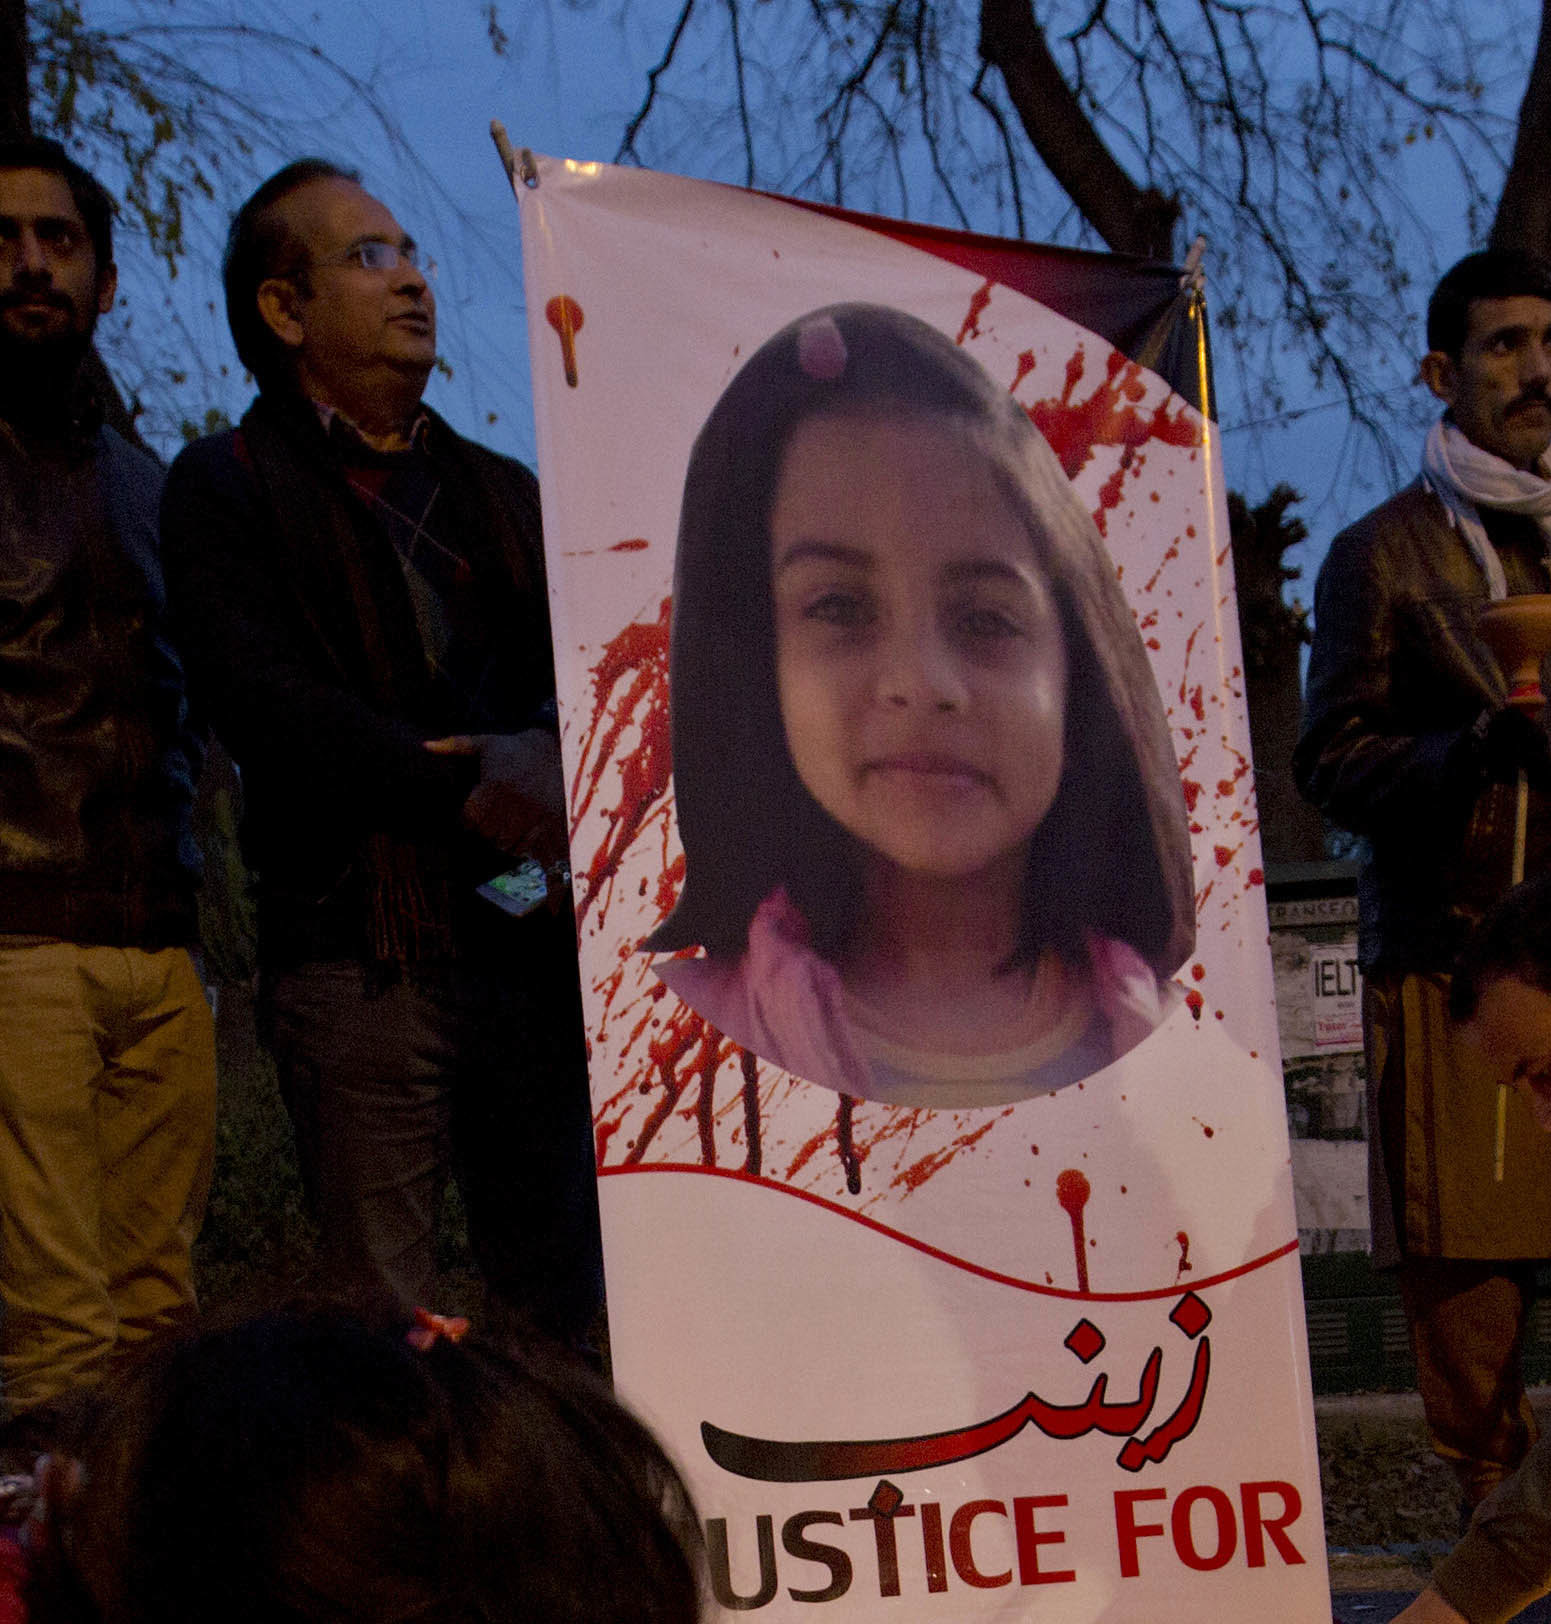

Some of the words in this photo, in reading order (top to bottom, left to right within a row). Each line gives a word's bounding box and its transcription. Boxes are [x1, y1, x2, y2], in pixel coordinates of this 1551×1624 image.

[1314, 959, 1358, 998] IELT
[705, 1494, 1077, 1612] USTICE
[1113, 1480, 1307, 1579] FOR
